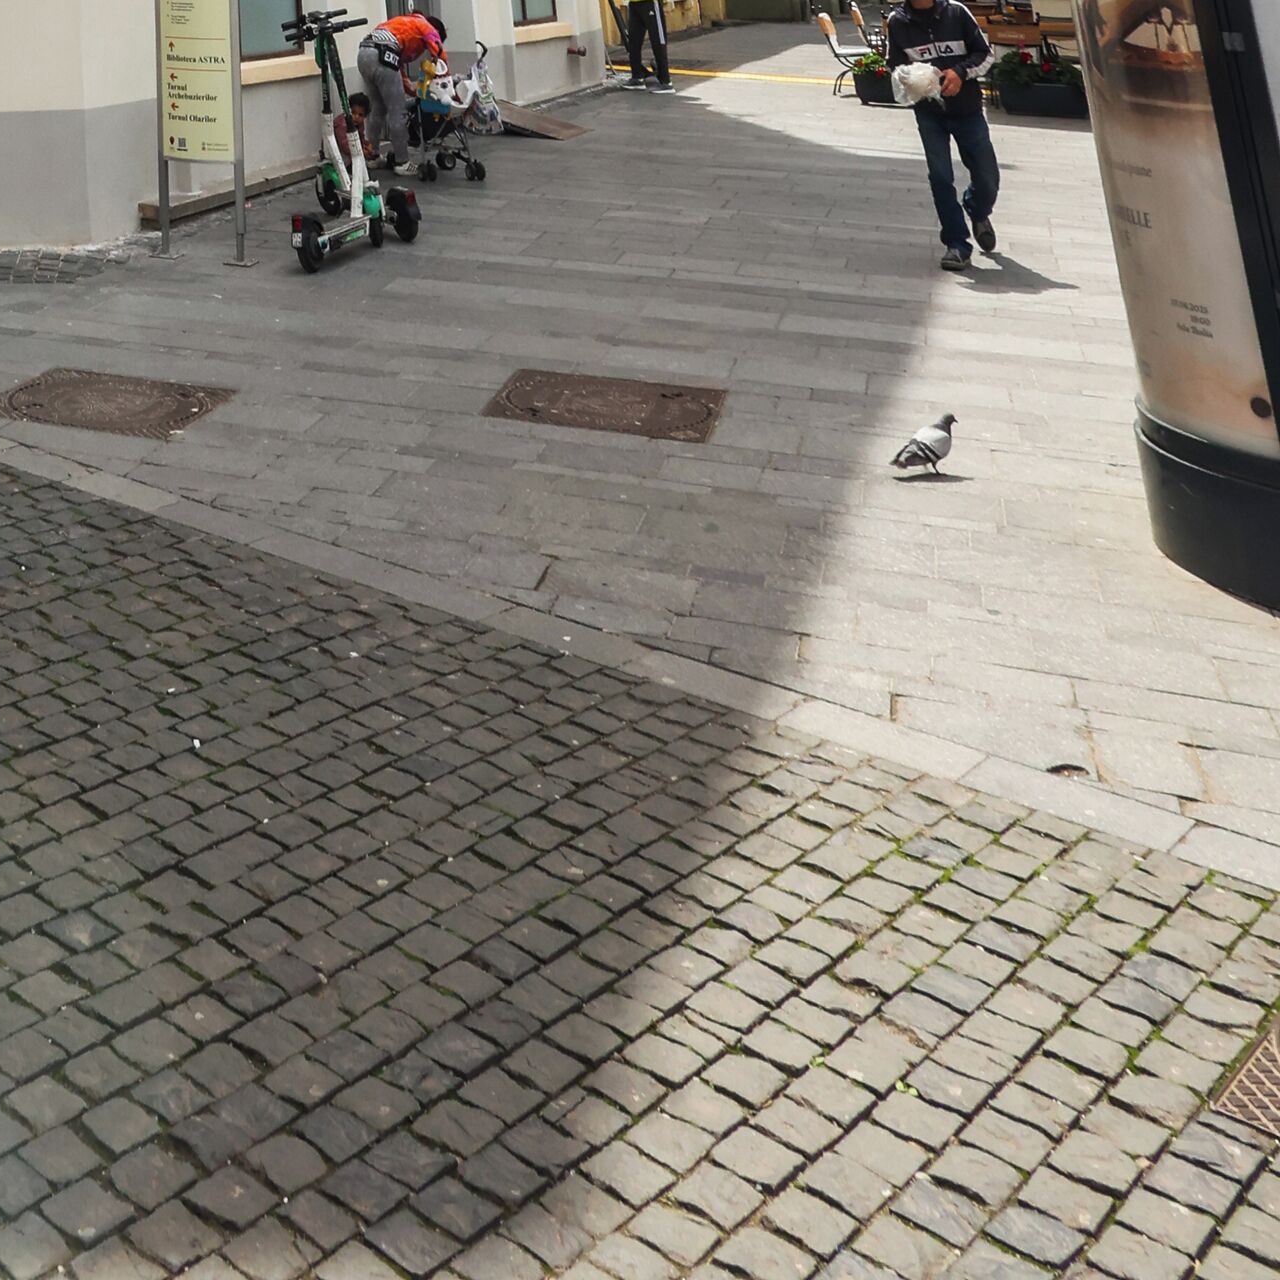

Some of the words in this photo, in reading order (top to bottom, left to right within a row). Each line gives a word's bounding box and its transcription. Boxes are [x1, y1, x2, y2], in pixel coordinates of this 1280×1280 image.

[167, 54, 196, 63] Biblioteca
[198, 56, 225, 64] ASTRA
[167, 83, 187, 91] Turnul
[168, 113, 188, 121] Turnul
[189, 114, 217, 123] Olarilor
